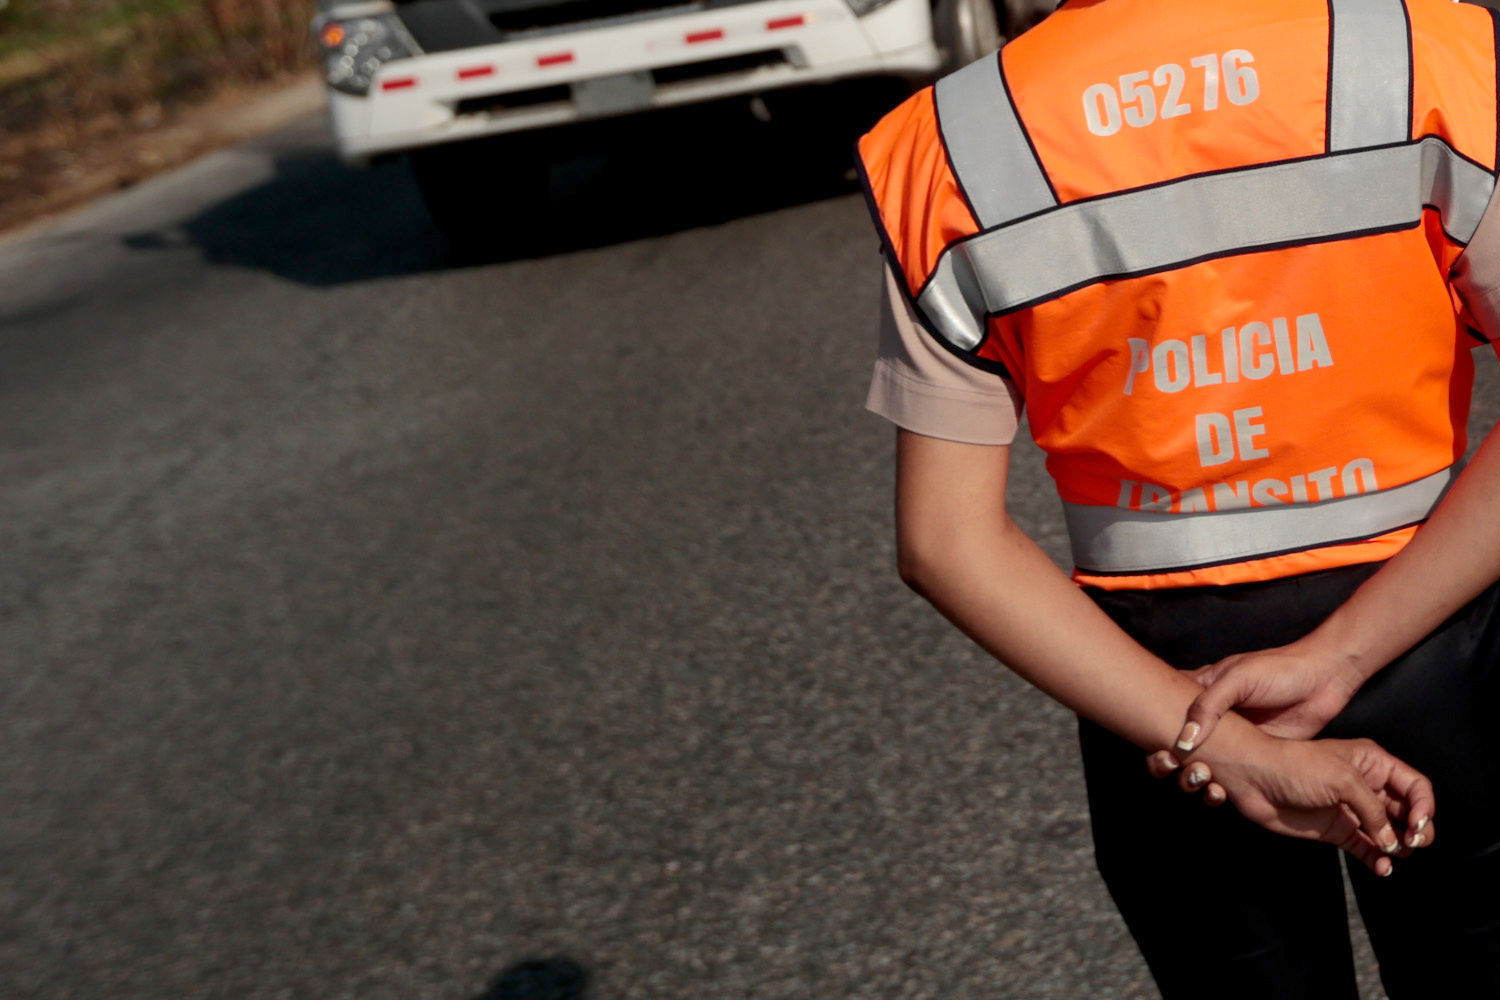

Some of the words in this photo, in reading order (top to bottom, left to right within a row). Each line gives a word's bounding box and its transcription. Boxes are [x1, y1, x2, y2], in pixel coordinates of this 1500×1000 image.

[1082, 49, 1260, 137] 05276
[1123, 313, 1333, 395] POLICIA
[1195, 406, 1269, 467] DE
